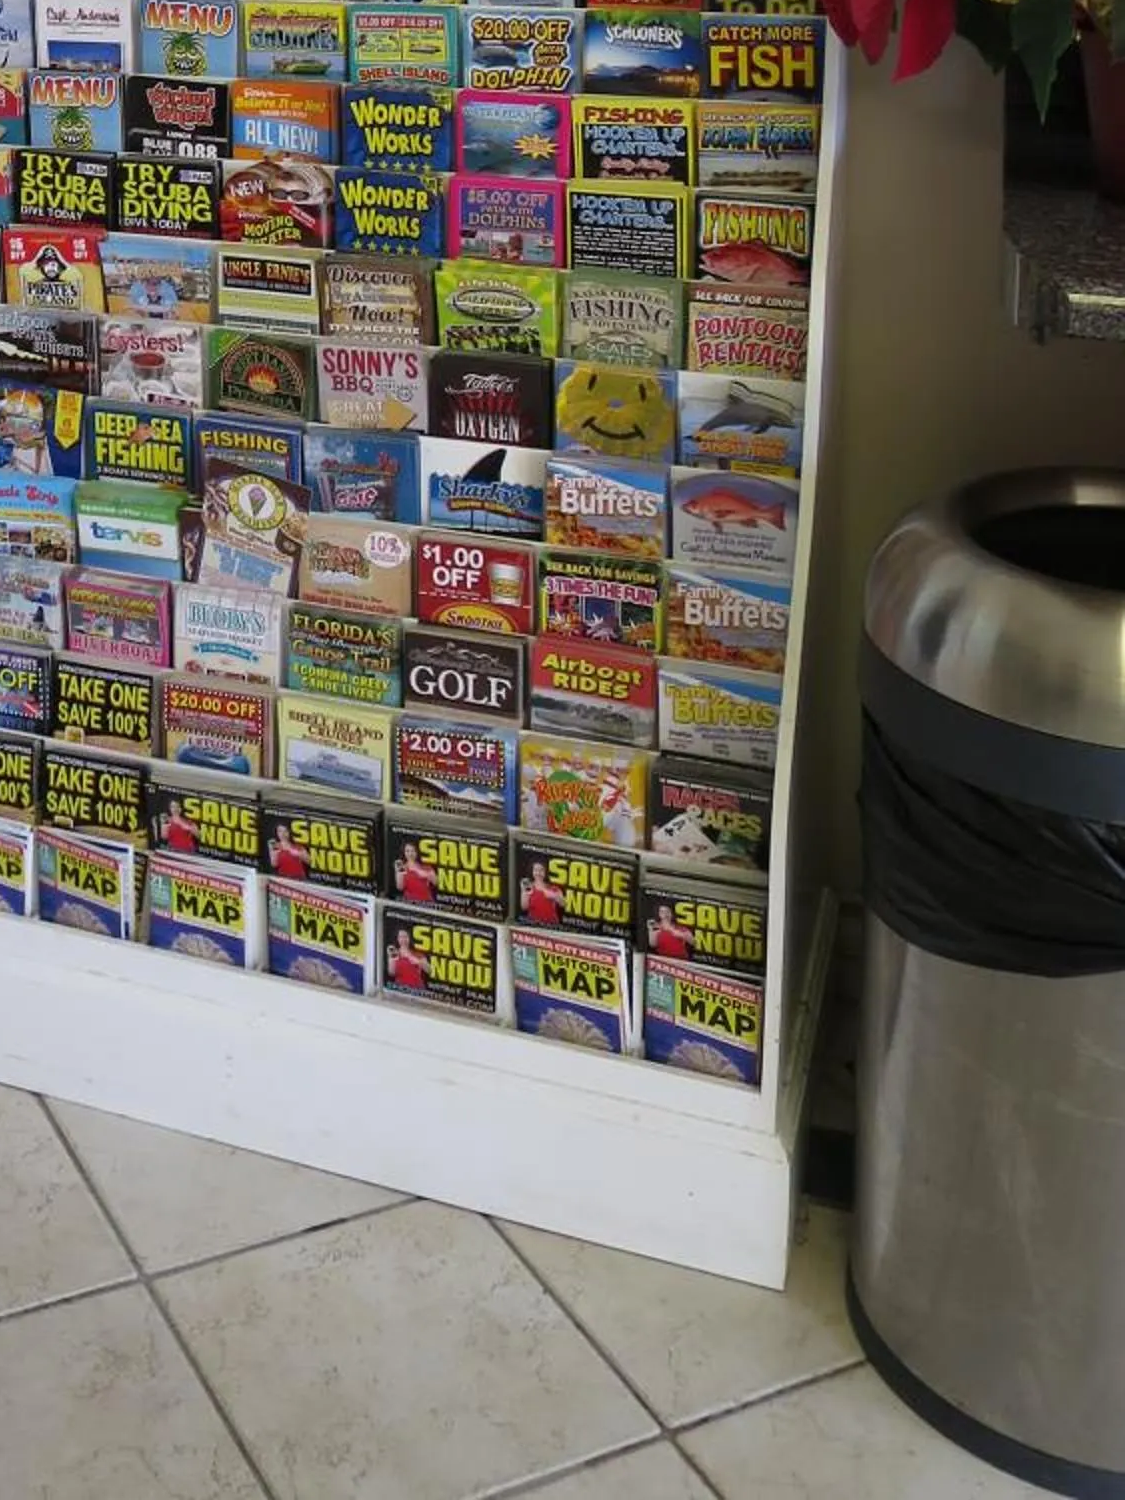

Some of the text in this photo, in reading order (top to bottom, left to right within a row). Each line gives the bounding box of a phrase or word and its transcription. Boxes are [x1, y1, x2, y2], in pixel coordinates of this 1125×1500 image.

[146, 0, 233, 36] MENU
[473, 18, 569, 40] $20.00 OFF
[708, 26, 813, 41] CATCH MORE
[359, 68, 448, 83] SHELL ISLAND
[473, 67, 571, 89] DOLPHIN
[709, 45, 815, 88] FISH
[31, 75, 116, 108] MENU
[584, 106, 685, 124] FISHING
[245, 119, 318, 153] ALL NEW!
[21, 153, 71, 172] TRY
[123, 163, 173, 183] TRY
[20, 170, 105, 196] SCUBA
[122, 182, 210, 206] SCUBA
[230, 180, 265, 197] NEW
[20, 190, 106, 215] DIVING
[123, 200, 212, 222] DIVING
[702, 201, 806, 254] FISHING
[570, 299, 674, 328] FISHING
[323, 349, 418, 380] SONNY'S
[331, 376, 374, 396] BBQ
[94, 411, 182, 444] DEEP SEA
[455, 411, 520, 442] OXYGEN
[95, 436, 184, 473] FISHING
[200, 431, 289, 454] FISHING
[560, 487, 658, 517] Buffets
[423, 544, 484, 569] $1.00
[433, 569, 482, 589] OFF
[558, 578, 595, 595] TIMES
[598, 583, 625, 598] THE
[683, 599, 786, 630] Buffets
[0, 668, 38, 691] OFF
[542, 654, 642, 685] Airboat
[59, 674, 149, 711] TAKE ONE
[409, 664, 512, 708] GOLF
[553, 673, 629, 700] RIDES
[58, 702, 103, 729] SAVE
[171, 692, 256, 717] $20.00 OFF
[673, 699, 775, 729] Buffets
[457, 741, 496, 760] OFF
[46, 764, 139, 804] TAKE ONE
[47, 793, 90, 821] SAVE
[183, 797, 257, 833] SAVE
[200, 823, 257, 854] NOW
[291, 820, 368, 854] SAVE
[310, 849, 370, 878] NOW
[418, 839, 500, 873] SAVE
[61, 863, 116, 898] MAP
[438, 869, 501, 899] NOW
[548, 858, 631, 897] SAVE
[177, 894, 241, 925] MAP
[294, 902, 360, 932] VISITOR'S
[565, 892, 631, 923] NOW
[675, 902, 762, 938] SAVE
[294, 914, 360, 951] MAP
[412, 925, 491, 964] SAVE
[695, 930, 763, 961] NOW
[429, 956, 492, 989] NOW
[540, 951, 615, 978] VISITOR'S
[542, 964, 615, 1000] MAP
[679, 981, 756, 1016] VISITOR'S
[680, 996, 756, 1036] MAP
